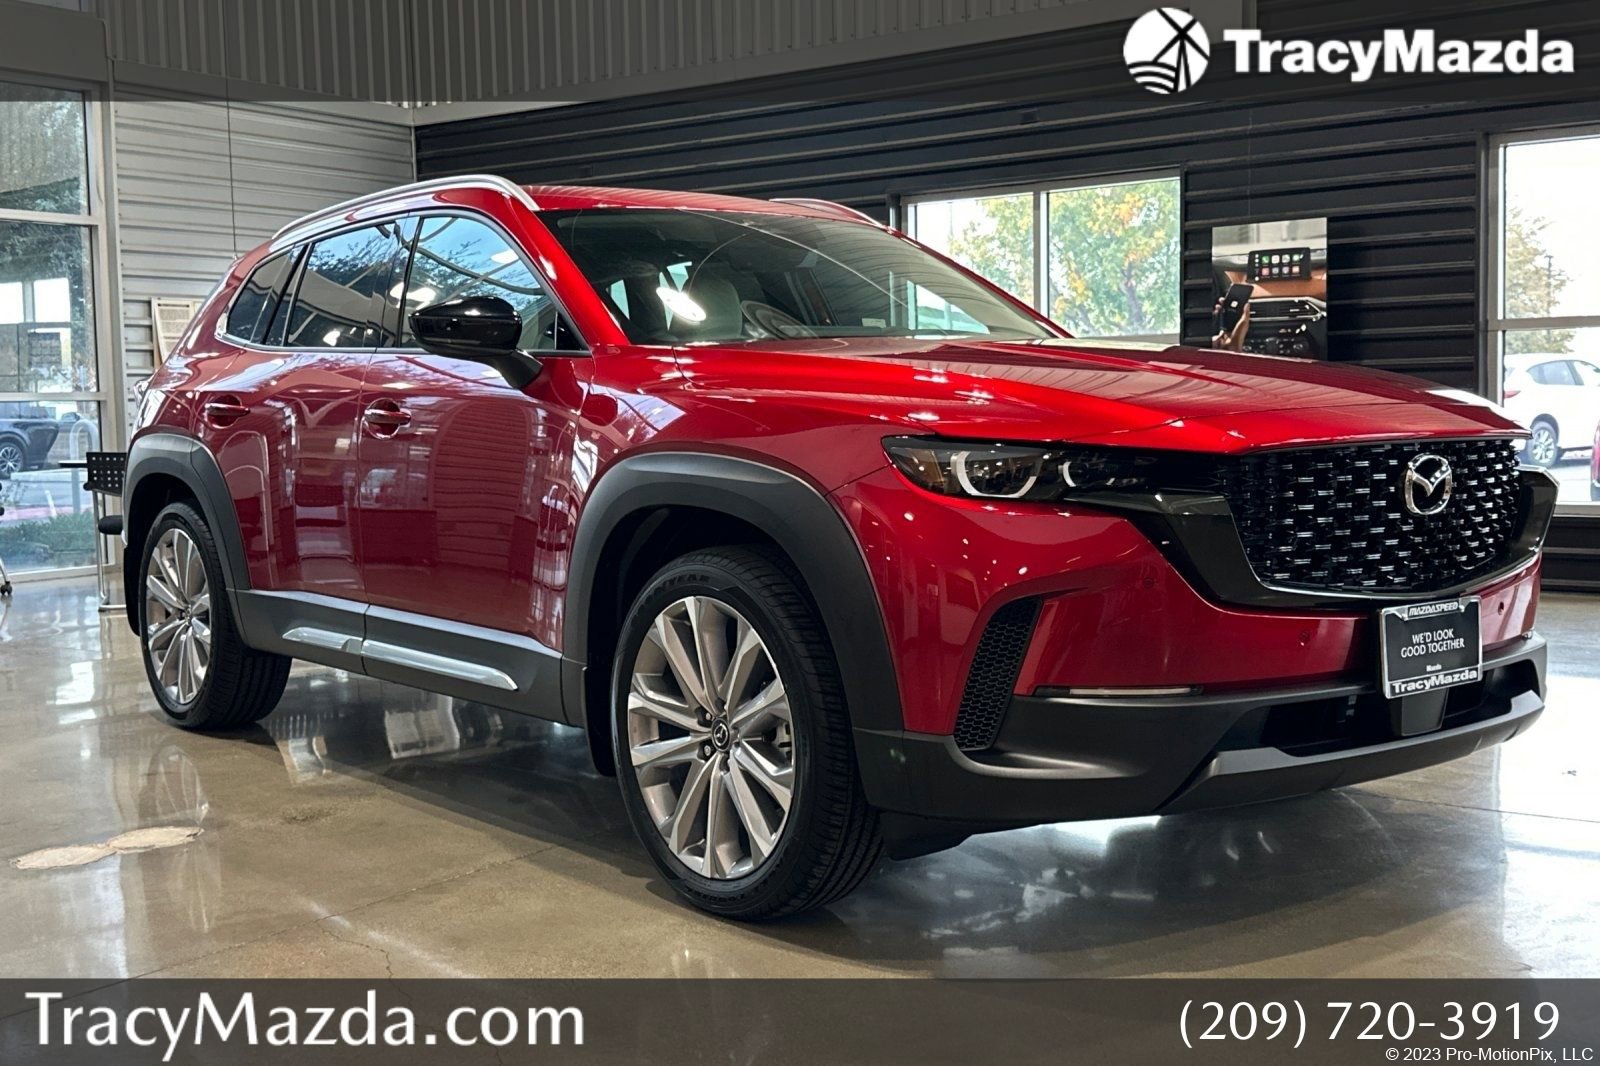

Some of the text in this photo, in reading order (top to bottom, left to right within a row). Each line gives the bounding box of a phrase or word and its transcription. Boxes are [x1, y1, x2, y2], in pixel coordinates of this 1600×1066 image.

[1409, 602, 1458, 616] MAZDASPEED
[1412, 628, 1454, 645] WE'D LOOK
[1401, 638, 1465, 658] GOOD TOGETHER
[1393, 670, 1477, 693] TracyMazda
